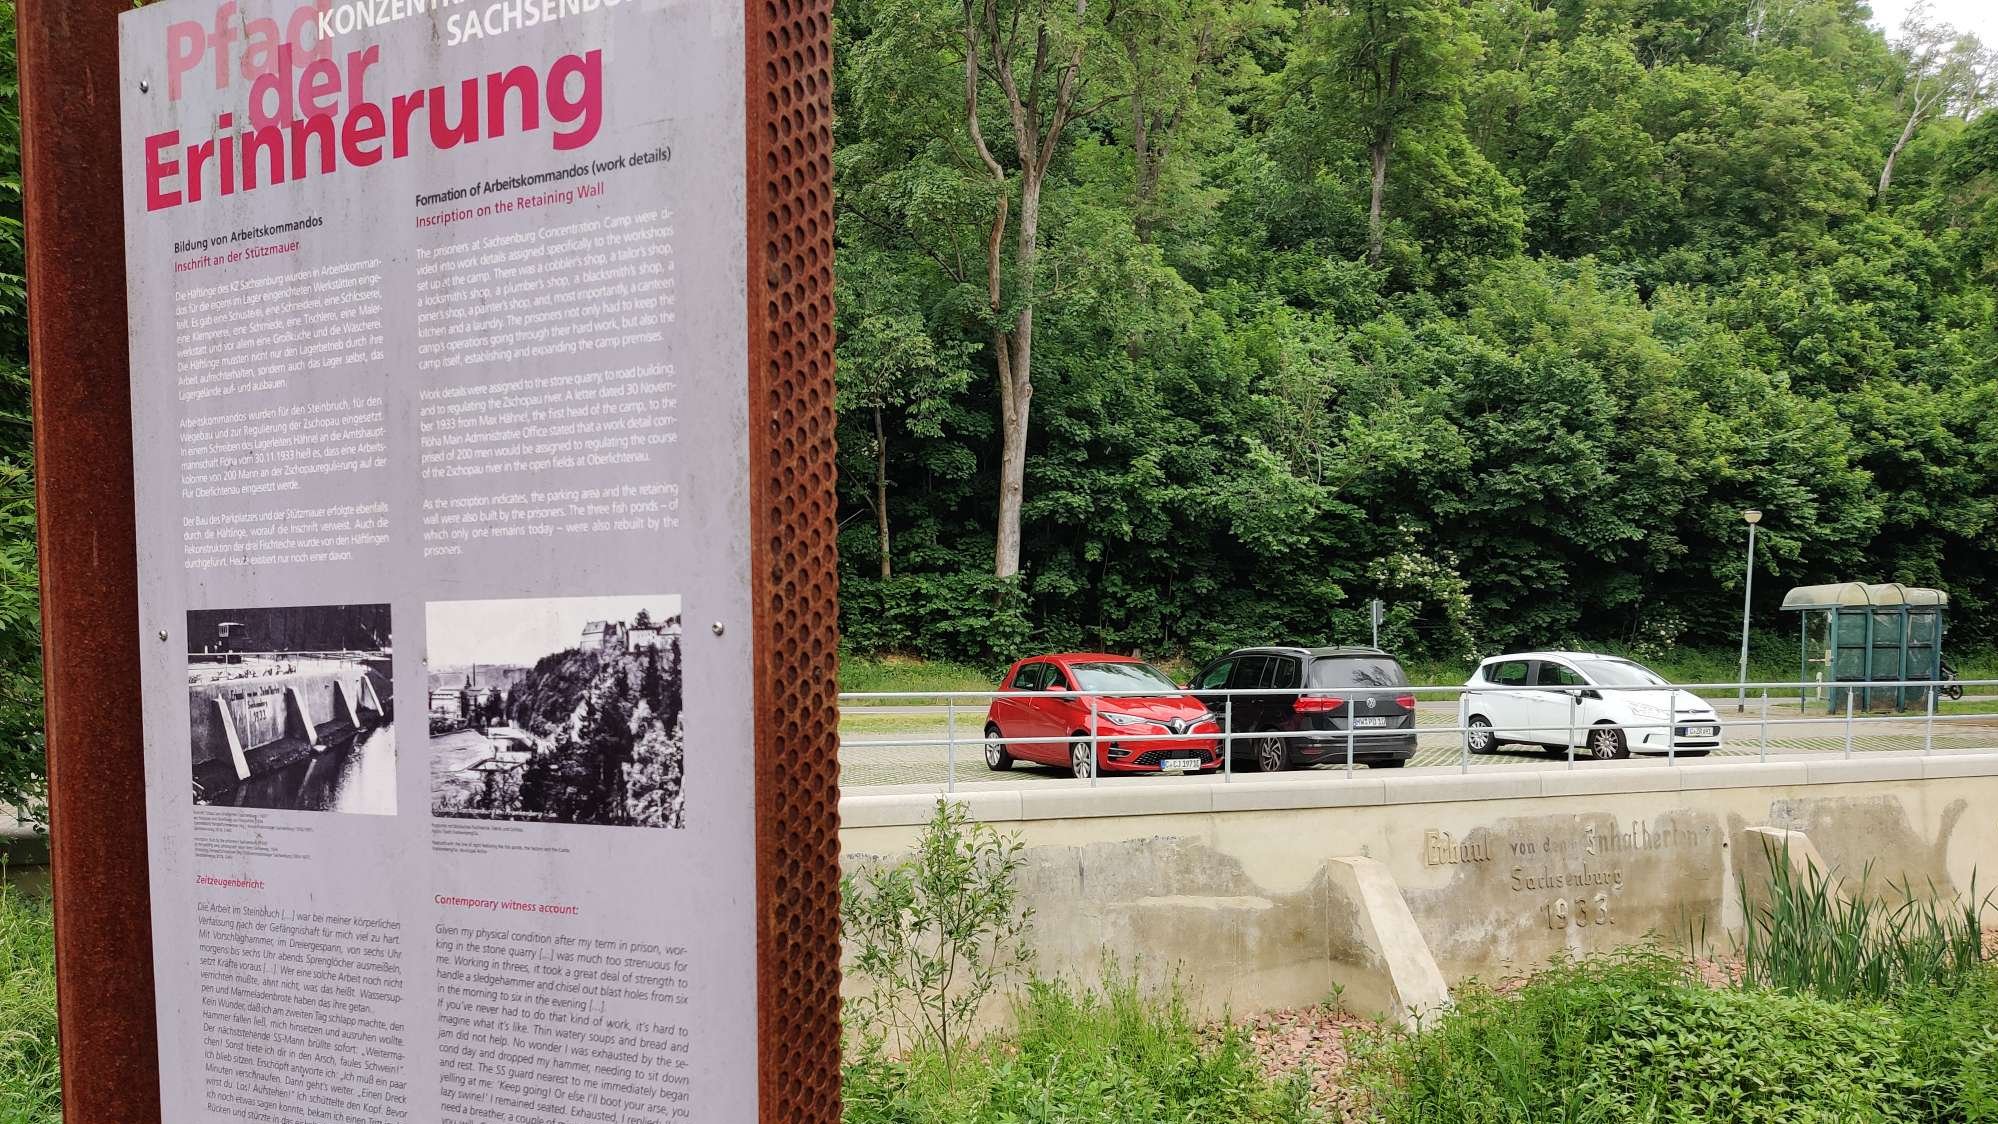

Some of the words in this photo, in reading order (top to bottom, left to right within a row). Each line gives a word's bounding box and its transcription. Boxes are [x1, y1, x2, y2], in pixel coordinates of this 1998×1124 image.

[319, 0, 464, 40] KONZEN
[447, 0, 632, 46] SACHSEN
[167, 0, 332, 102] Pfad
[249, 43, 380, 131] der
[145, 49, 602, 212] Erinnerung
[416, 189, 467, 207] Formation
[470, 183, 482, 196] of
[483, 164, 589, 194] Arbeitskommandos
[591, 155, 626, 176] (work
[628, 147, 672, 167] details)
[416, 207, 473, 228] Inscription
[476, 205, 491, 218] on
[495, 200, 513, 214] the
[517, 189, 573, 209] Retaining
[577, 182, 605, 199] Wall
[174, 237, 208, 254] Bildung
[211, 234, 228, 246] von
[231, 216, 324, 242] Arbeitskommandos
[416, 246, 431, 258] The
[433, 240, 469, 258] prisoners
[482, 229, 535, 251] Sachsenburg
[538, 219, 600, 239] Concentration
[603, 214, 631, 232] Camp
[634, 213, 657, 225] were
[661, 207, 674, 220] di-
[174, 255, 210, 272] Inschrift
[213, 254, 225, 266] an
[227, 250, 243, 263] der
[245, 240, 300, 260] Stützmauer
[1510, 842, 1536, 856] von
[196, 875, 265, 889] Zeitzeugenbericht:
[434, 894, 498, 912] Contemporary
[501, 900, 536, 912] witness
[539, 903, 578, 915] account:
[435, 924, 458, 935] Given
[475, 927, 508, 942] physical
[511, 930, 551, 943] condition
[554, 934, 576, 946] after
[594, 938, 616, 949] term
[630, 941, 661, 956] prison,
[665, 946, 687, 956] wor-
[435, 938, 453, 952] king
[466, 941, 480, 952] the
[482, 943, 506, 954] stone
[508, 947, 536, 960] quarry
[556, 952, 573, 961] was
[576, 952, 601, 964] much
[605, 954, 621, 966] too
[623, 956, 671, 970] strenuous
[673, 961, 688, 972] for
[455, 955, 489, 970] Working
[502, 960, 529, 974] threes,
[542, 964, 562, 975] took
[573, 967, 597, 981] great
[600, 969, 620, 981] deal
[634, 973, 674, 989] strength
[437, 1013, 470, 1028] imagine
[473, 1017, 494, 1028] what
[512, 1022, 529, 1033] like.
[533, 1024, 551, 1036] Thin
[555, 1027, 585, 1042] watery
[588, 1033, 615, 1046] soups
[618, 1034, 636, 1046] and
[639, 1037, 668, 1050] bread
[669, 1040, 689, 1052] and
[475, 1004, 499, 1014] never
[501, 1005, 518, 1016] had
[548, 1010, 566, 1022] that
[570, 1013, 589, 1024] kind
[606, 1017, 632, 1032] work,
[653, 1022, 675, 1034] hard
[439, 1042, 458, 1054] cond
[461, 1045, 475, 1058] day
[478, 1047, 495, 1058] and
[497, 1050, 533, 1066] dropped
[552, 1057, 590, 1074] hammer,
[594, 1062, 631, 1079] needing
[648, 1069, 658, 1080] sit
[661, 1071, 689, 1084] down
